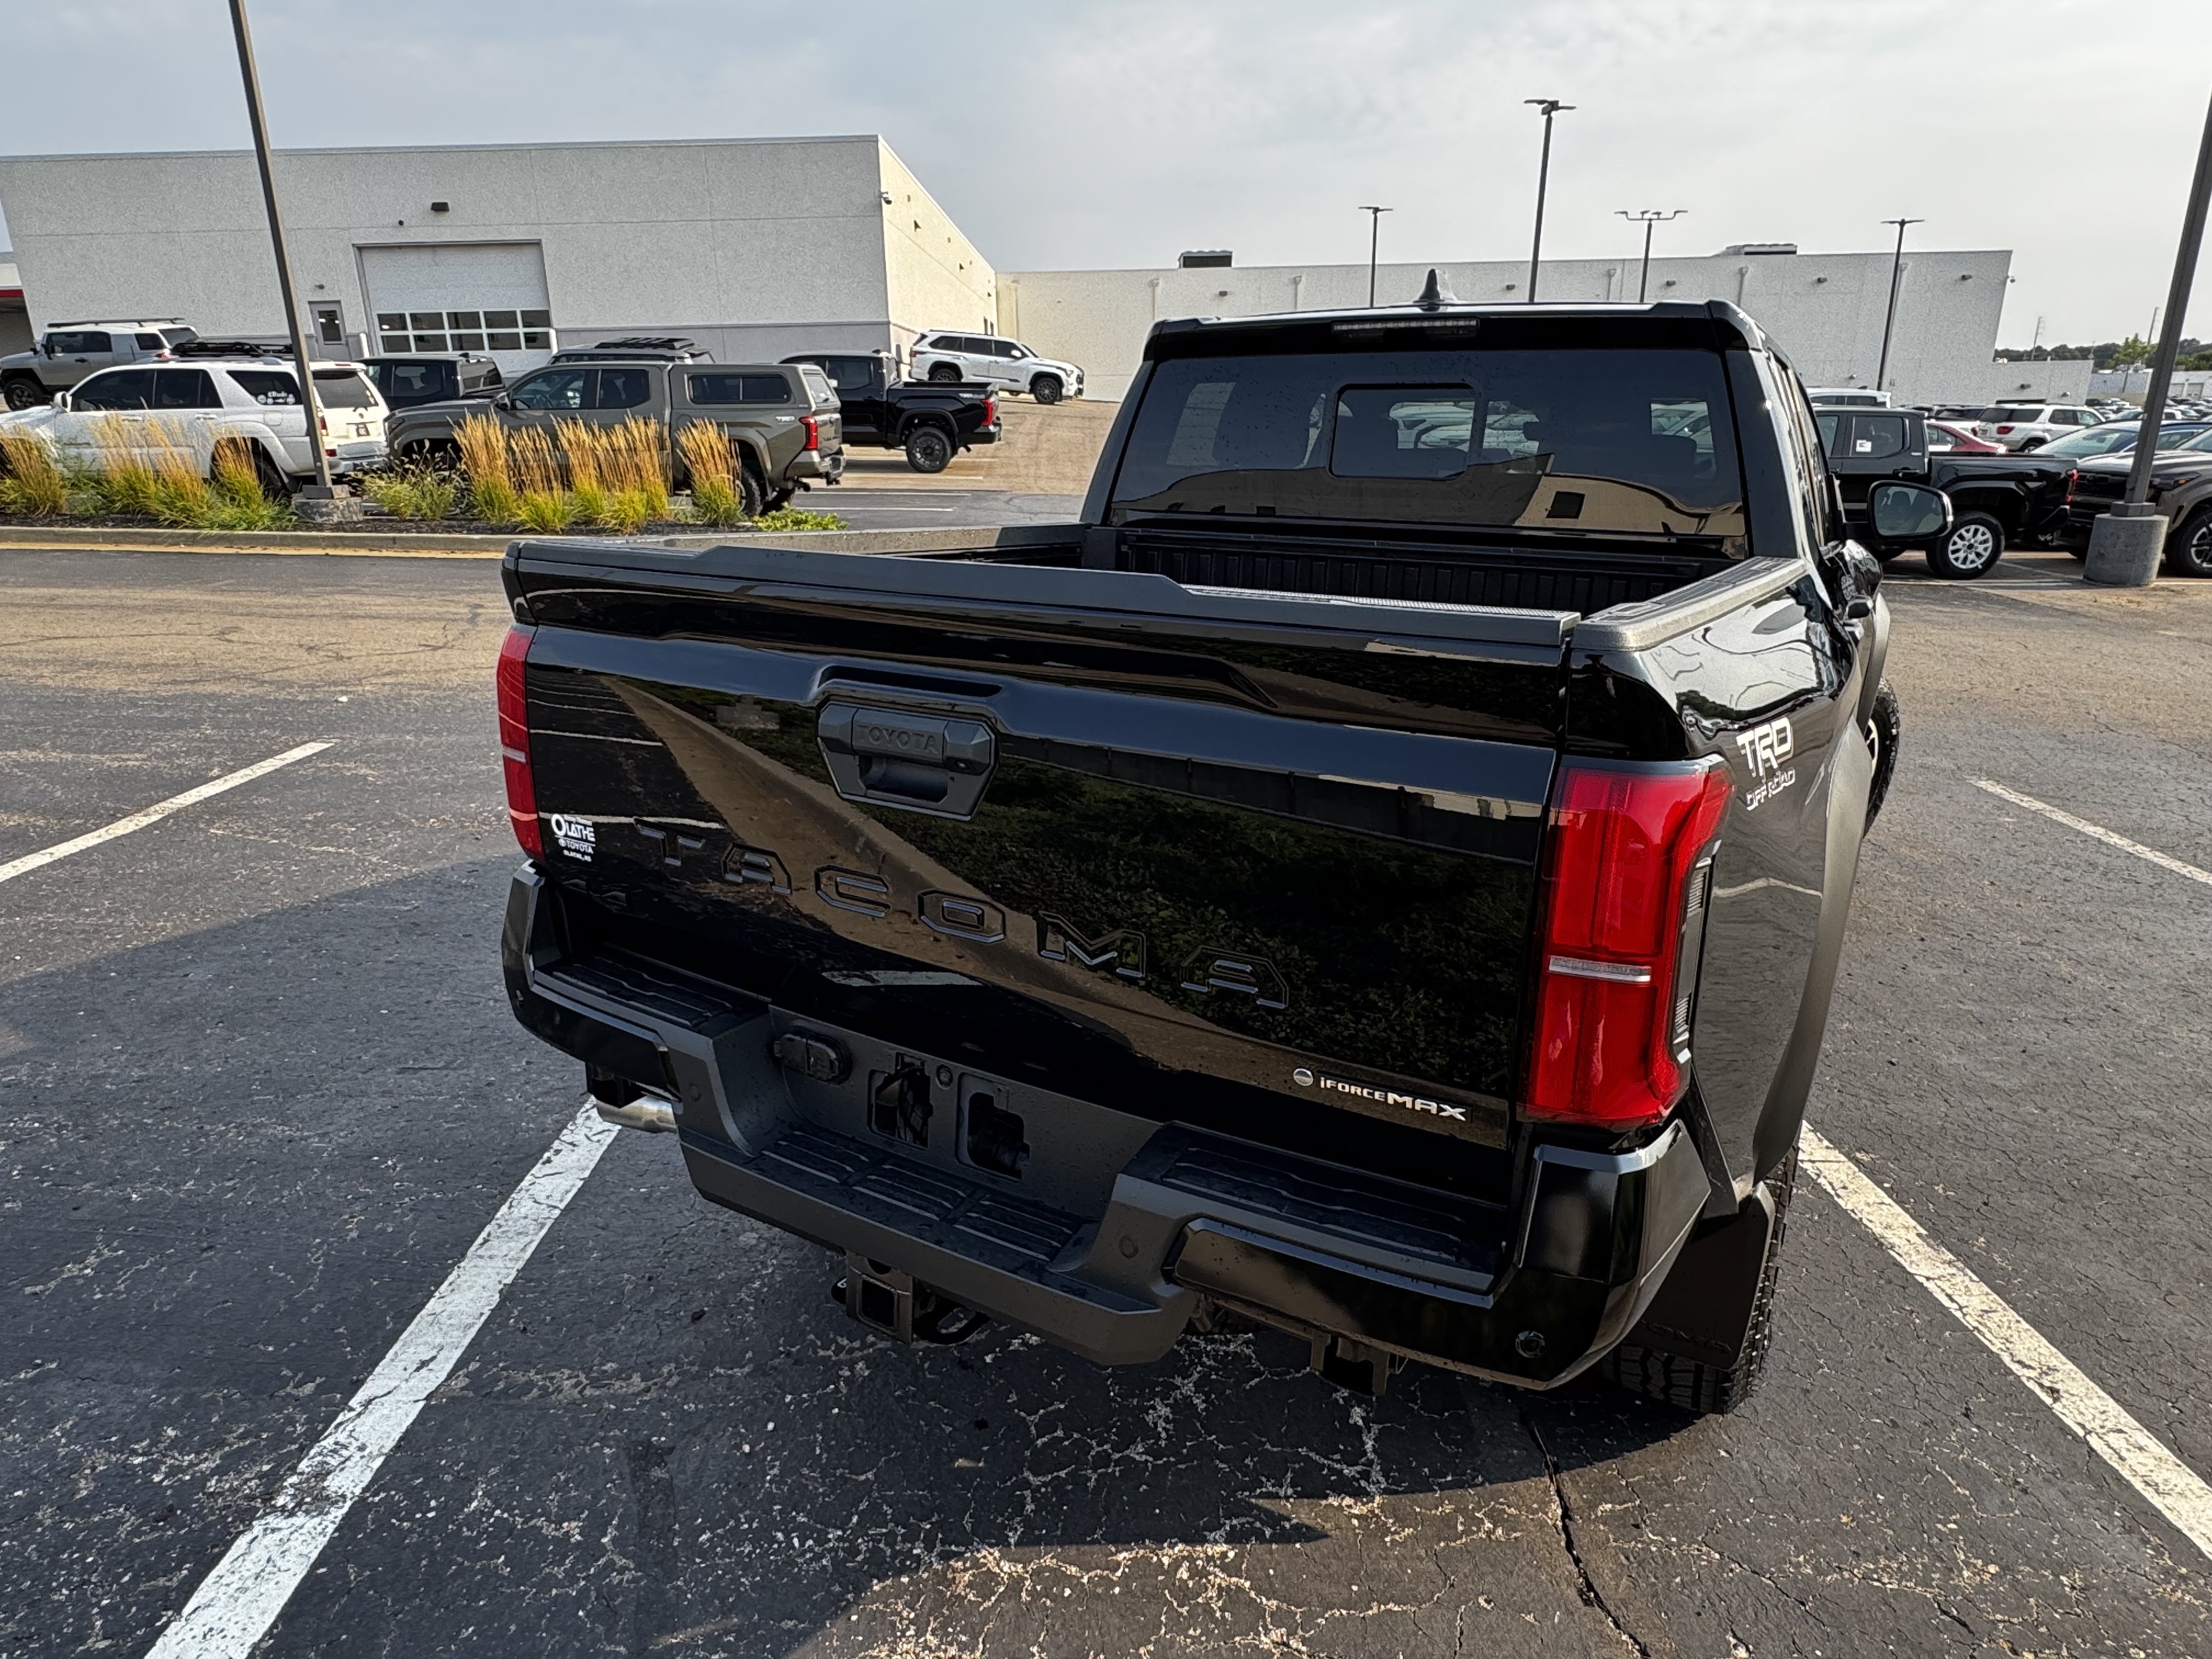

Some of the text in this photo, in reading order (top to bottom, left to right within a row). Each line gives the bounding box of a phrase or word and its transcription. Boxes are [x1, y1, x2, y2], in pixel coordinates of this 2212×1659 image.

[856, 724, 939, 754] TOYOTA
[1736, 717, 1792, 777] TRD
[1746, 768, 1795, 811] OFF ROAD
[551, 814, 595, 841] OLATHE
[566, 840, 594, 854] TOYOTA
[632, 816, 1290, 1009] TACOMA
